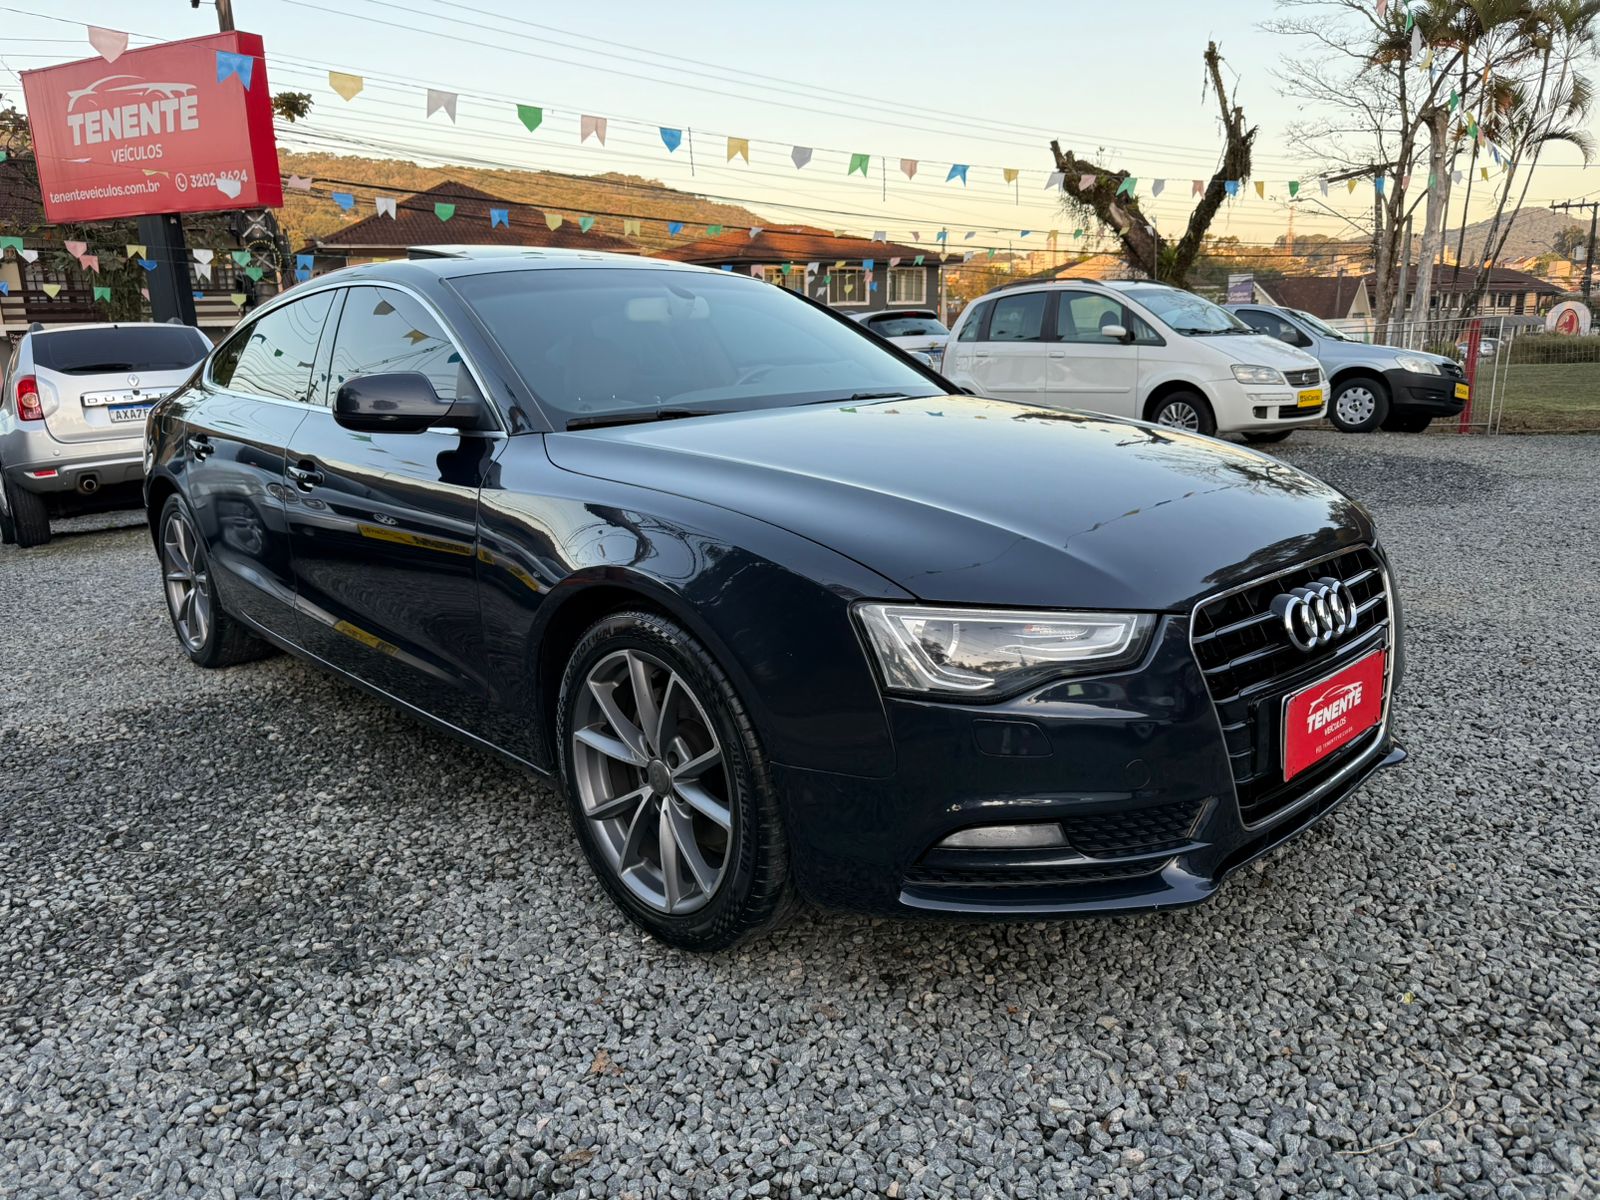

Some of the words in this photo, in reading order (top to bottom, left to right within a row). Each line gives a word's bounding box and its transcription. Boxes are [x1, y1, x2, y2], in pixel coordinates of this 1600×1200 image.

[67, 95, 199, 146] TENENTE
[111, 143, 163, 164] VEÍCULOS
[190, 169, 248, 188] 32028624
[50, 178, 160, 204] tenenteveiculos.com.br
[87, 392, 169, 404] DUSTE
[1306, 685, 1363, 734] TENENTE
